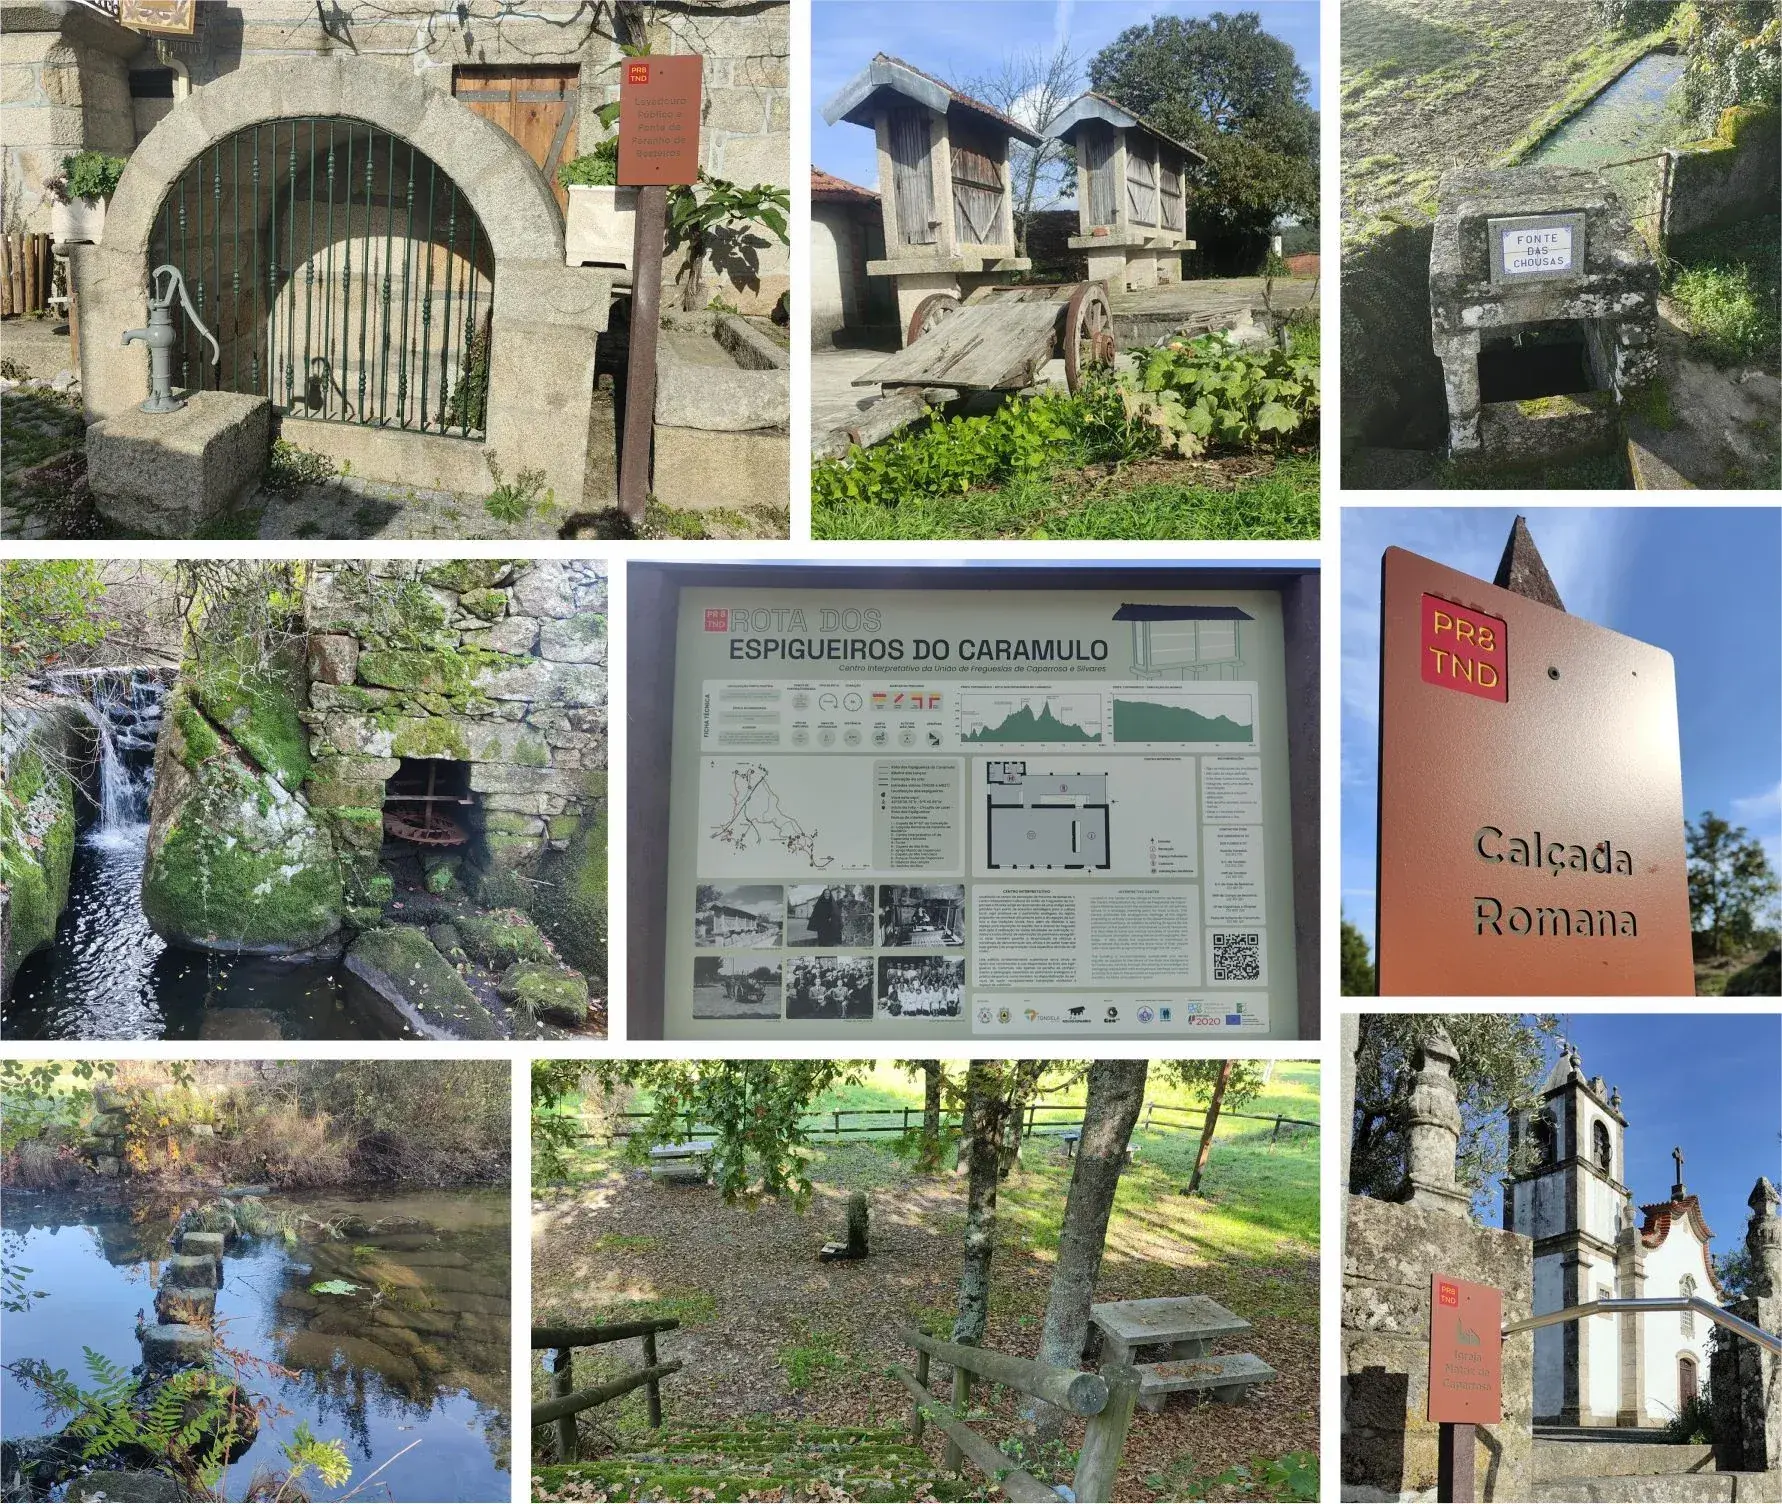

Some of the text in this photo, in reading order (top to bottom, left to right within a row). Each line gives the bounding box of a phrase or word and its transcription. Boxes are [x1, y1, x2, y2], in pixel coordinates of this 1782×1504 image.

[1517, 234, 1557, 244] FONTE
[1527, 246, 1548, 255] DAS
[1513, 257, 1563, 267] CHOUSAS
[706, 620, 726, 628] TND
[731, 608, 882, 632] ROTA DOS
[1434, 610, 1496, 652] PR8
[730, 638, 1108, 661] ESPIGUEIROS DO CARAMULO
[839, 664, 866, 672] Centro
[867, 664, 920, 673] Interpretativo
[934, 665, 957, 673] União
[970, 665, 1012, 674] Freguesias
[1026, 665, 1067, 674] Caparrosa
[1429, 647, 1499, 689] TND
[1473, 826, 1633, 877] Calçada
[1474, 896, 1638, 937] Romana
[1442, 1295, 1456, 1303] TND
